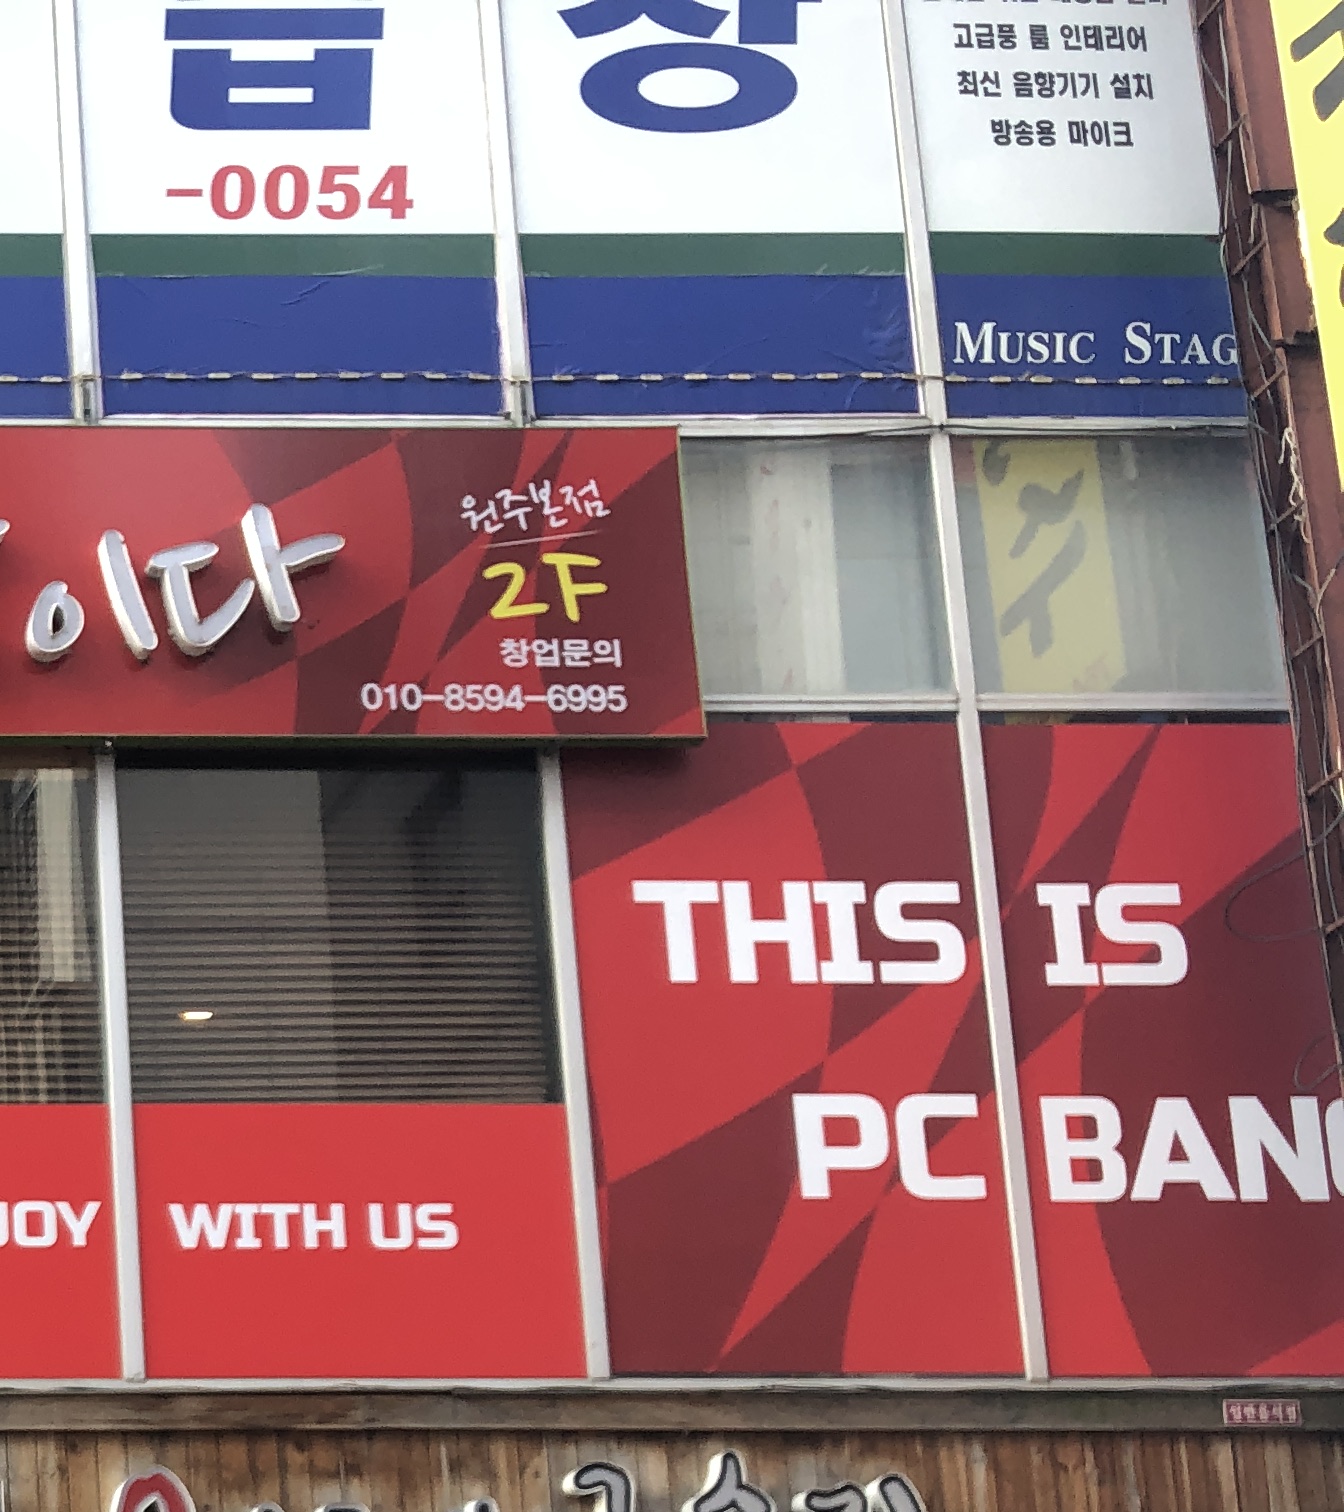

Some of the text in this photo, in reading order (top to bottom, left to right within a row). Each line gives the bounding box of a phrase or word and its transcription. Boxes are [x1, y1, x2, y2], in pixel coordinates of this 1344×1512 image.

[953, 23, 1148, 52] 고급풍 룸 인테리어
[957, 70, 1154, 99] 최신 음향기기 설치
[991, 119, 1134, 147] 방송용 마이크
[459, 478, 611, 534] 원주본점
[483, 552, 608, 624] 2F
[499, 637, 624, 670] 창업문의
[362, 681, 628, 714] 010-8594-6995
[632, 880, 1189, 987] THIS IS
[792, 1093, 1344, 1202] PC BAN
[168, 1203, 350, 1251] WITH
[368, 1202, 460, 1251] US
